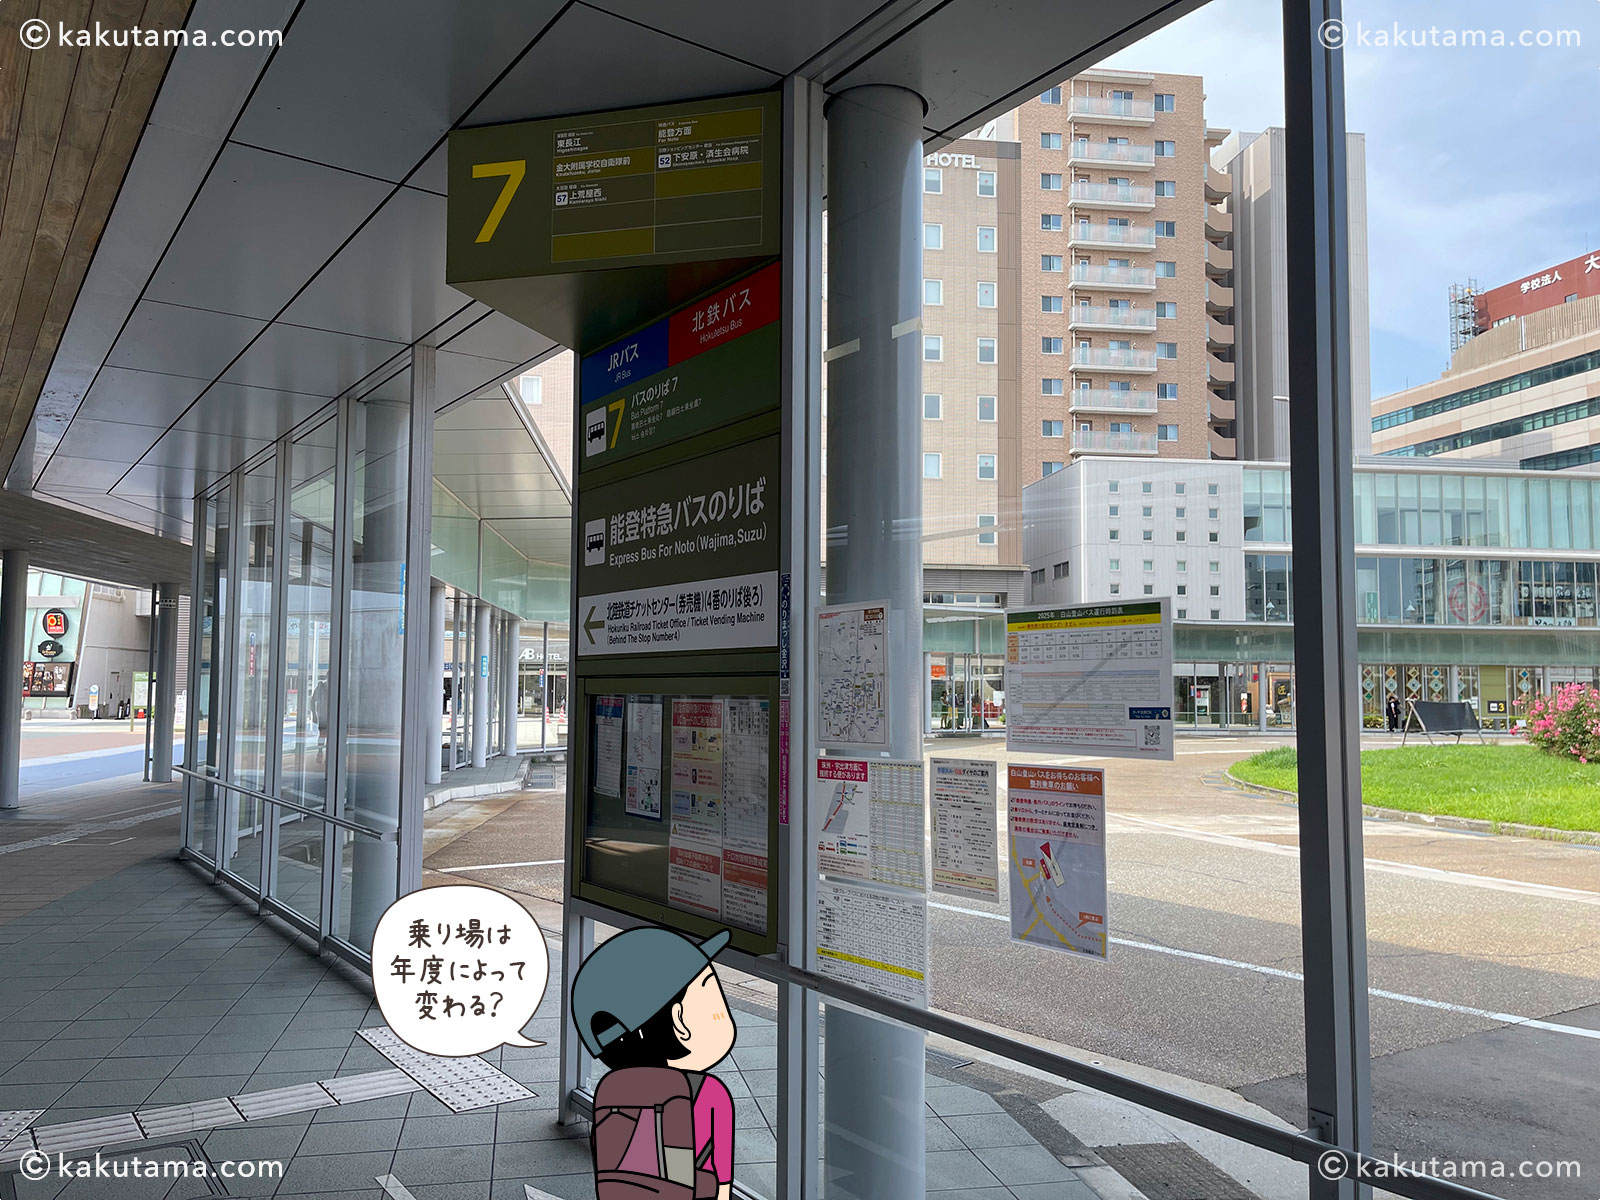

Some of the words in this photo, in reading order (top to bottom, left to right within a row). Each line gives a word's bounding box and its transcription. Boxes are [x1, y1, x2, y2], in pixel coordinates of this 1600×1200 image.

[658, 126, 693, 139] 能登方面
[659, 156, 671, 166] 52
[926, 152, 982, 170] HOTEL
[471, 159, 527, 244] 7
[557, 194, 568, 203] 57
[1520, 270, 1562, 295] 学校法人
[1584, 255, 1600, 275] 大
[691, 287, 752, 333] 北鉄バス
[699, 325, 730, 345] Hokutetsu
[729, 319, 743, 331] Bus
[607, 343, 639, 371] JRバス
[621, 369, 632, 380] Bus
[630, 380, 670, 408] バスのりば
[610, 398, 627, 449] 7
[610, 475, 767, 546] 能登特急バスのりば
[609, 549, 640, 568] Express
[640, 545, 657, 561] Bus
[658, 542, 673, 557] For
[674, 537, 695, 555] Noto
[629, 621, 652, 636] Railroad
[652, 618, 670, 634] Ticket
[669, 616, 687, 633] Office
[690, 613, 710, 630] Ticket
[709, 612, 736, 631] Vending
[736, 610, 765, 628] Machine
[627, 634, 638, 648] The
[638, 632, 651, 648] Stop
[518, 647, 535, 660] AB
[1497, 703, 1505, 712] 3
